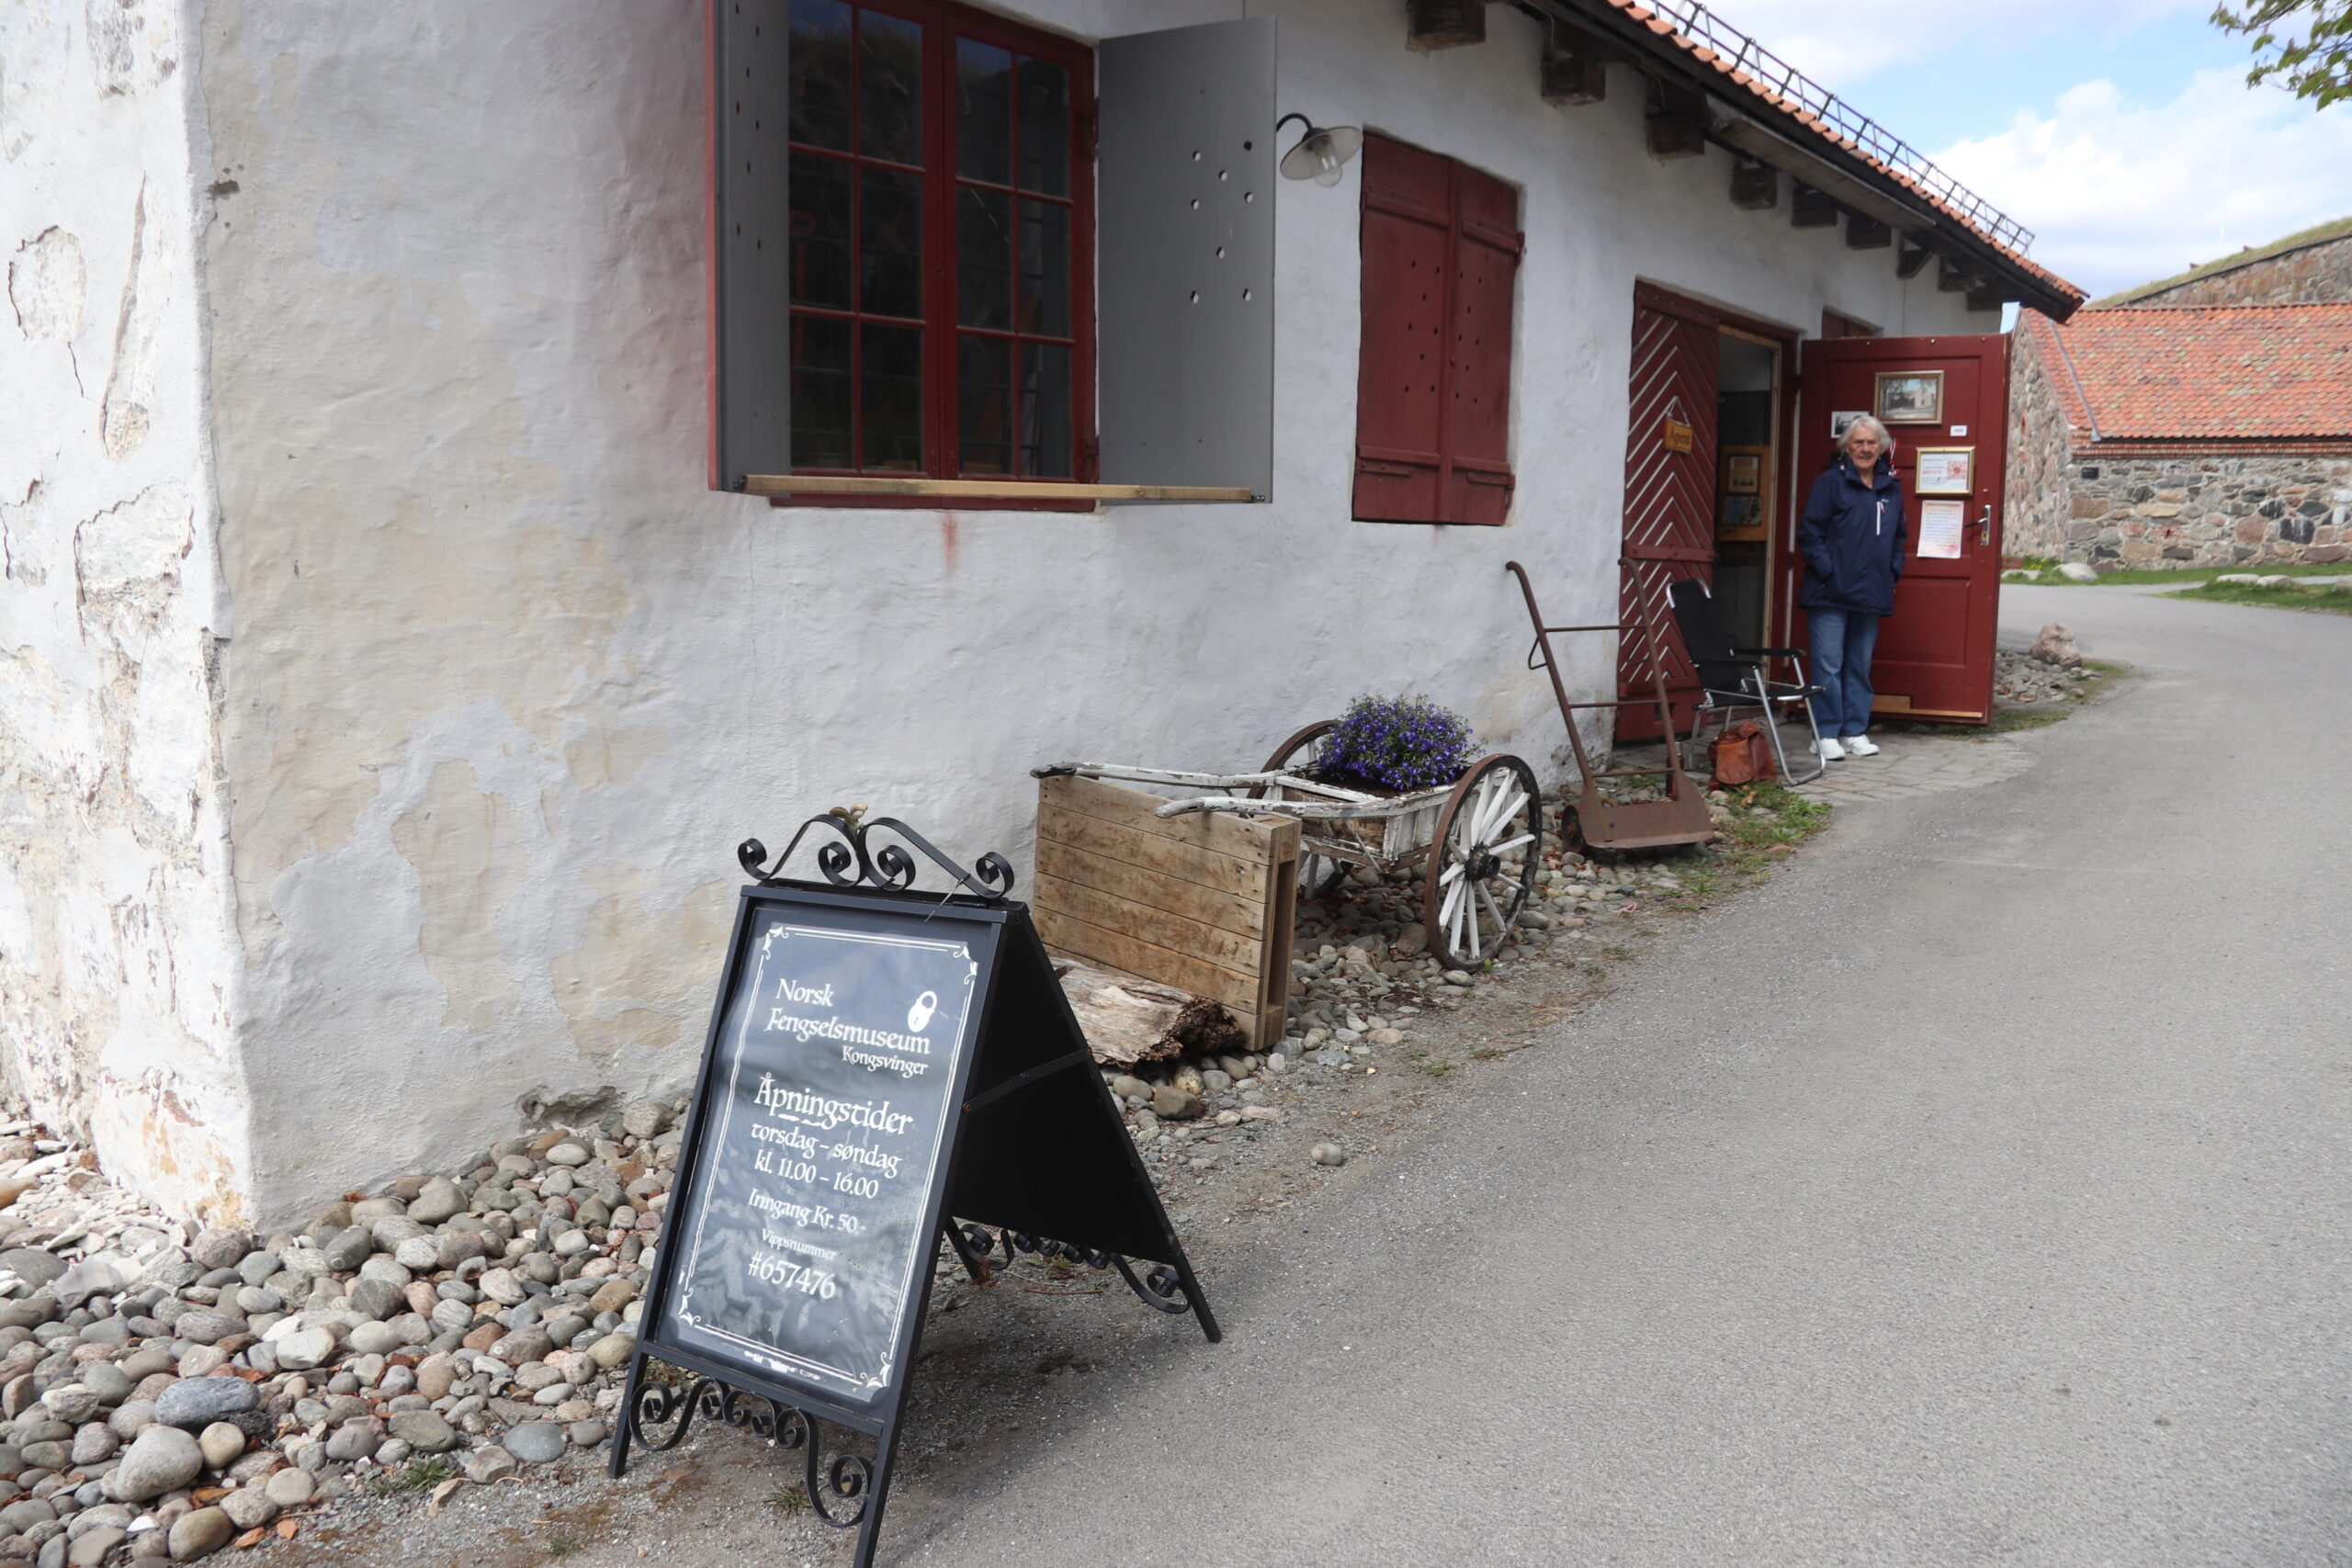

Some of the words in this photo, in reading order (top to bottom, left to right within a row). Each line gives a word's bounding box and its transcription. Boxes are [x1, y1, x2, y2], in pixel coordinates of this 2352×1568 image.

[775, 977, 834, 1007] Norsk
[763, 1008, 932, 1055] Fengselsmuseum
[842, 1045, 929, 1078] Kongsvinger
[753, 1072, 914, 1134] Åpningstider
[751, 1122, 820, 1159] torsdag
[831, 1143, 903, 1179] søndag
[753, 1149, 773, 1175] kl.
[777, 1157, 817, 1183] 11.00
[832, 1171, 879, 1199] 16.00
[748, 1188, 813, 1227] Inngang
[811, 1204, 834, 1229] Kr.
[761, 1227, 837, 1260] Vippsnummer
[748, 1250, 837, 1300] #657476
